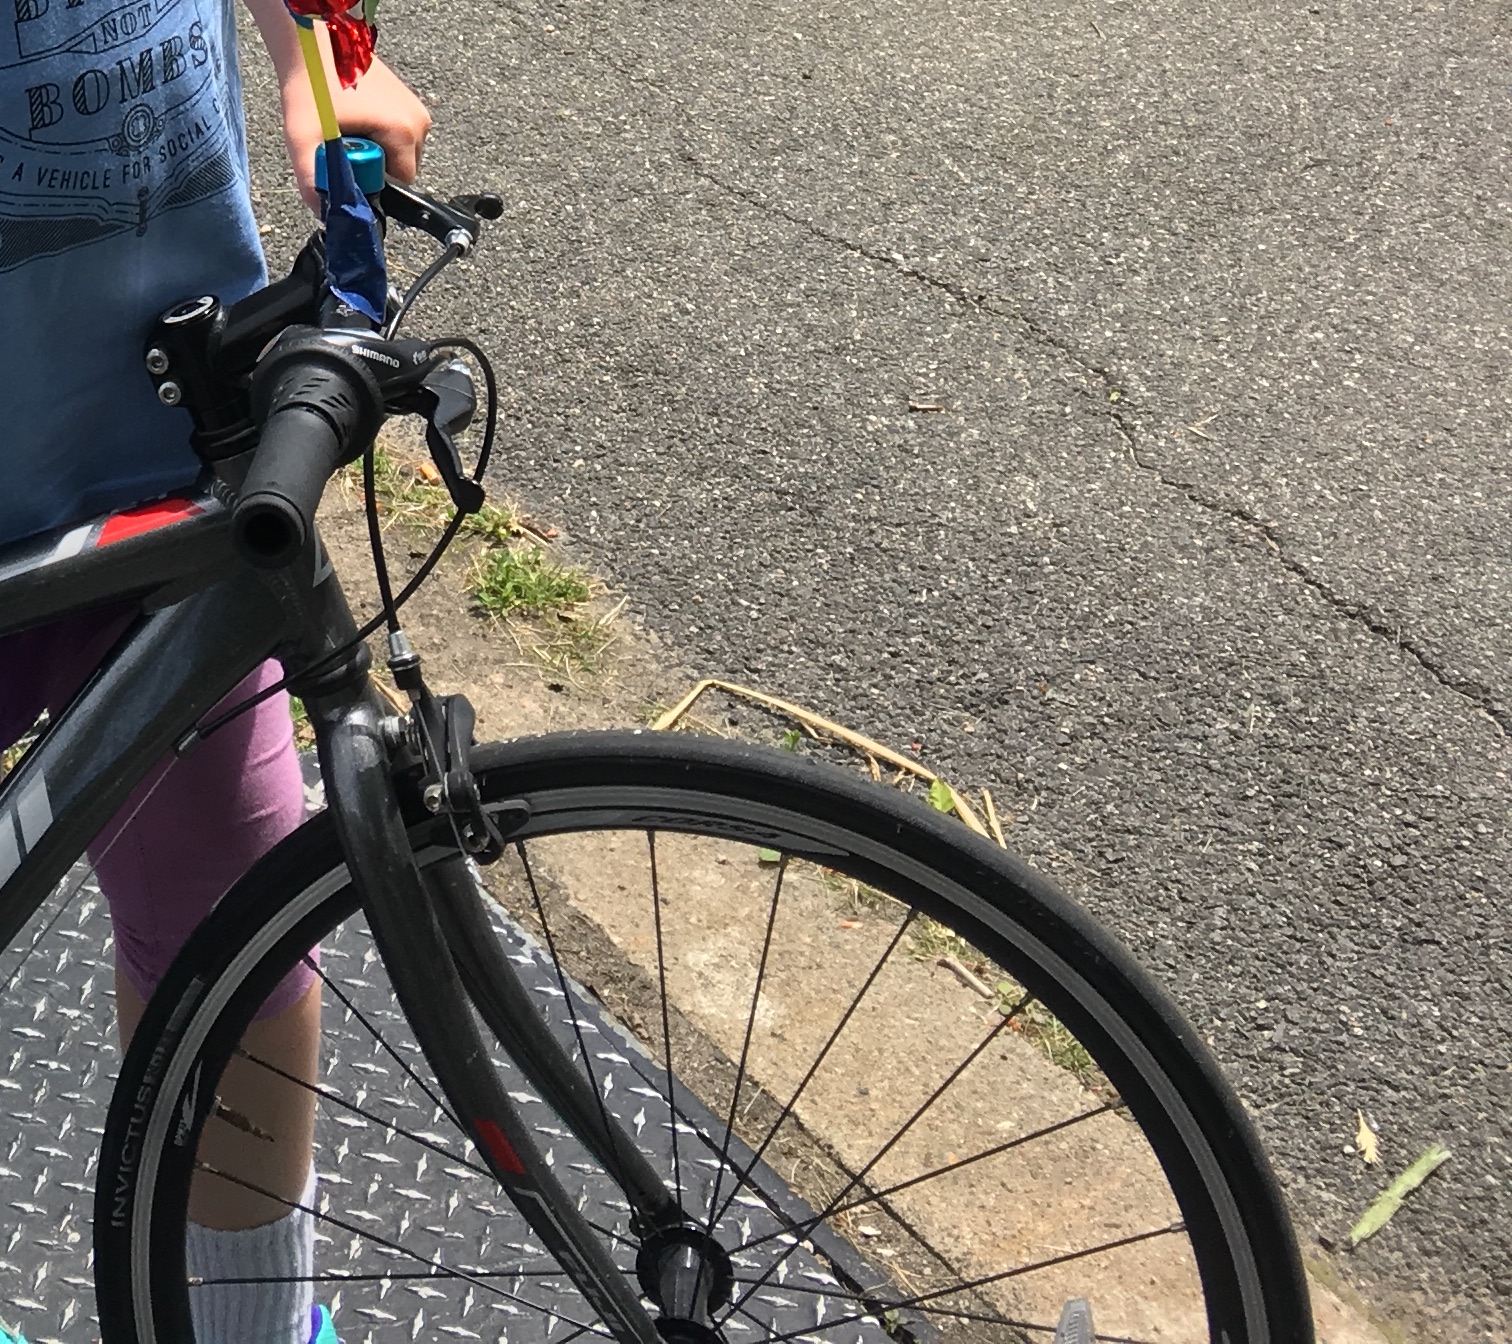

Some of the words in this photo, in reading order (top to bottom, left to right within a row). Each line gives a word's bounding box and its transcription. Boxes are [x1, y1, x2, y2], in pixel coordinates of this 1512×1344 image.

[101, 3, 152, 45] NOT
[25, 21, 209, 131] BOMBS
[11, 163, 25, 182] A
[37, 166, 112, 191] VEHICLE
[122, 156, 152, 184] FOR
[158, 116, 212, 163] SOCIAL
[351, 344, 400, 369] SHIMANO
